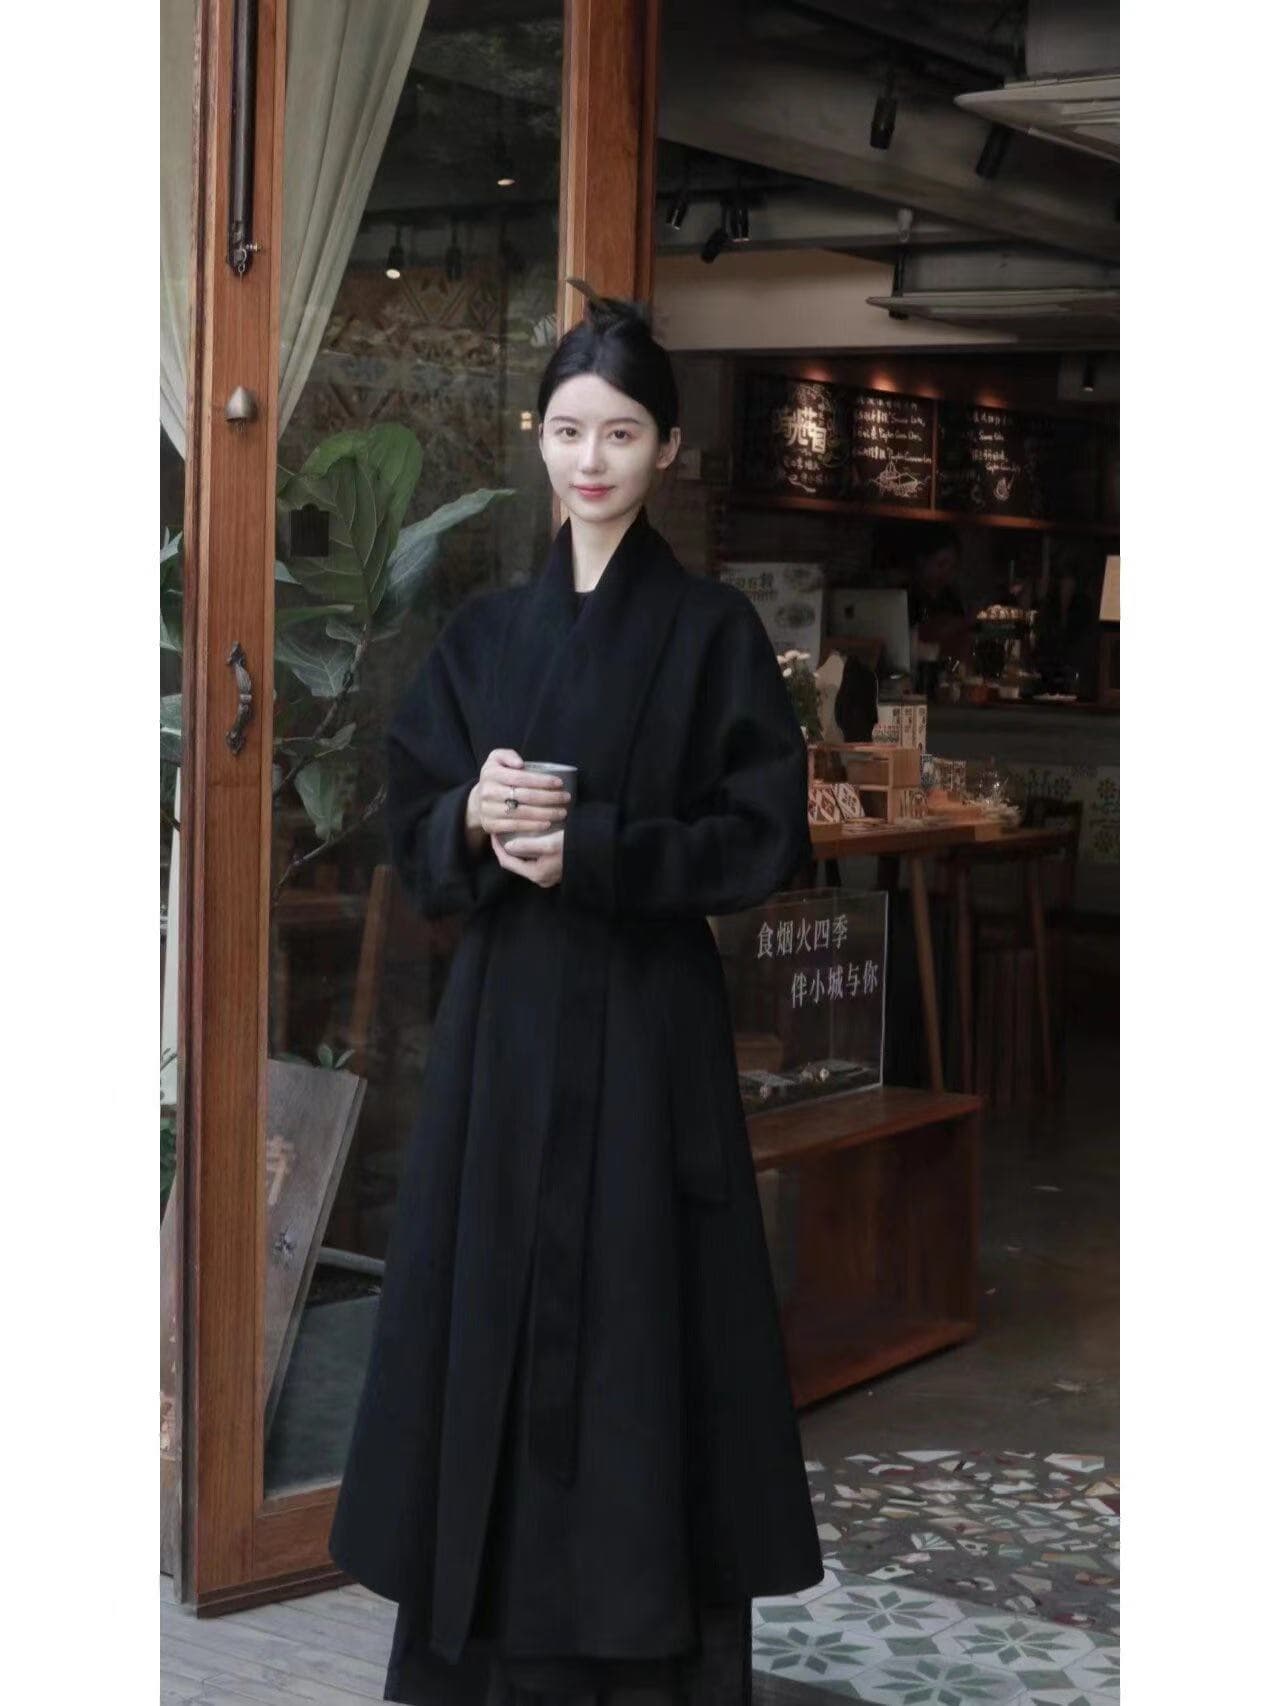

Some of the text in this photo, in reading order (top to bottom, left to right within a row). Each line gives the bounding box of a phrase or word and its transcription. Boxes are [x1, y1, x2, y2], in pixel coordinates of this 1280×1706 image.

[757, 914, 848, 959] 食烟火四季
[791, 960, 879, 1009] 伴小城与你
